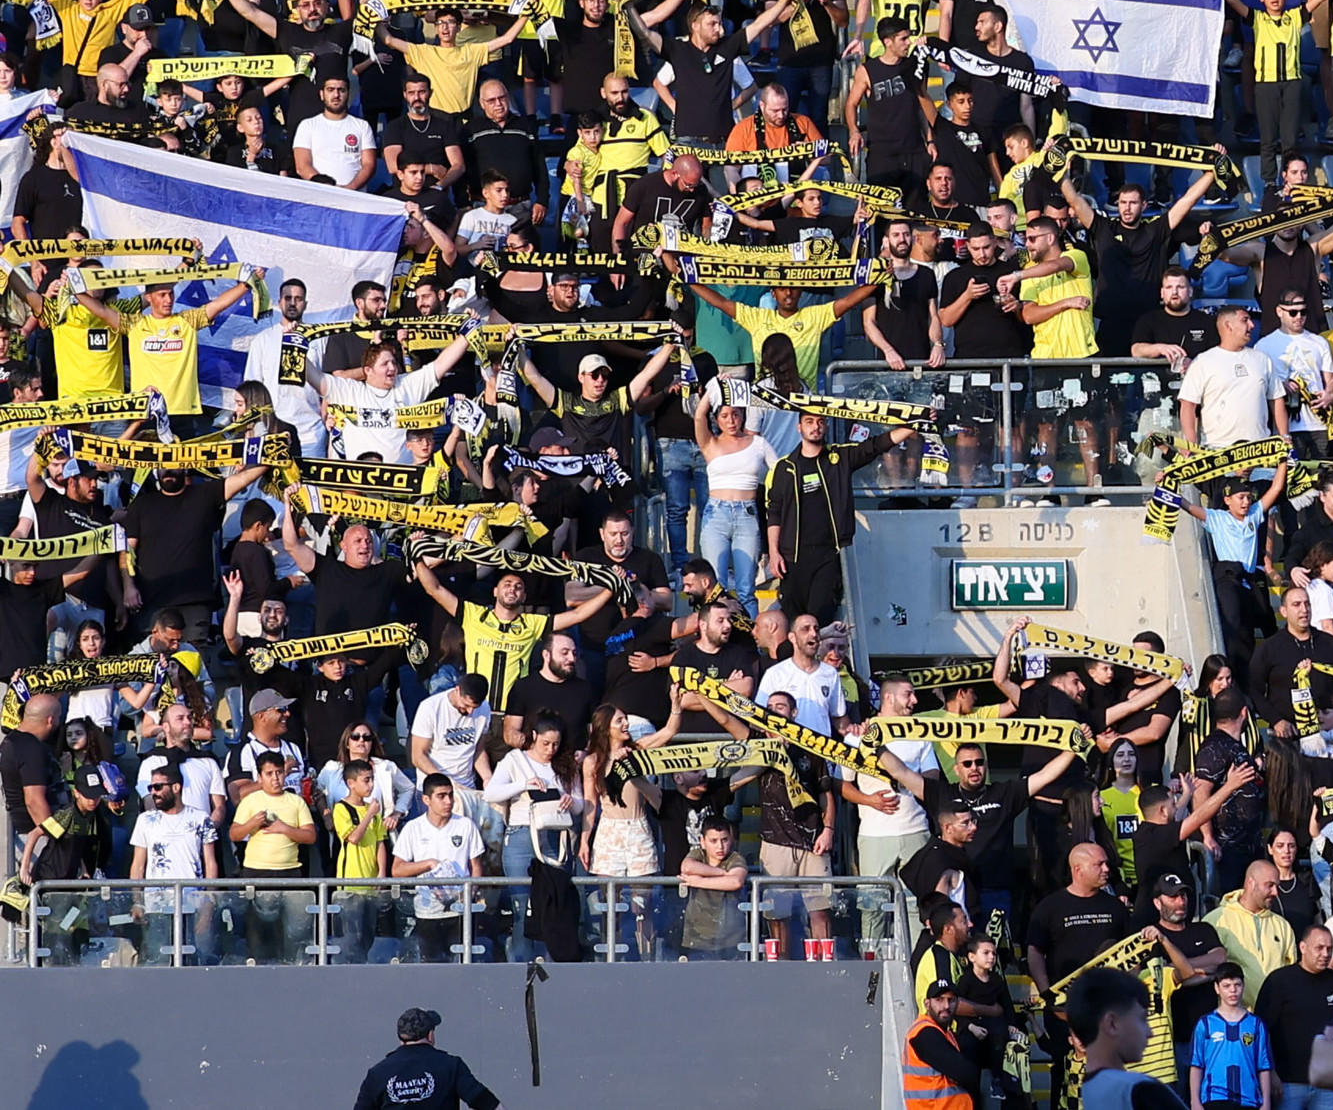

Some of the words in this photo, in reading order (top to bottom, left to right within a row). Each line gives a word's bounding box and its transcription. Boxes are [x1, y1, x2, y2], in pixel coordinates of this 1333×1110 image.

[162, 59, 225, 75] ירושלים
[232, 56, 275, 71] בית"ר
[1007, 75, 1032, 94] WITH
[1033, 83, 1051, 98] US!
[1072, 138, 1153, 157] ירושלים
[1155, 143, 1205, 163] בית"ר
[89, 333, 106, 346] 1&1
[788, 391, 925, 418] ירושלים
[818, 406, 890, 424] JERUSALEM
[322, 492, 385, 515] ירושלים
[412, 504, 467, 528] בית"ר
[1019, 522, 1075, 543] כניסה
[0, 538, 88, 558] ירושלי
[1045, 628, 1172, 668] ירושלים
[909, 662, 993, 687] ירושלים
[886, 718, 986, 740] ירושלים
[996, 720, 1064, 744] בית"ר
[1119, 820, 1138, 835] 1&1
[394, 1078, 428, 1090] MAAYAN
